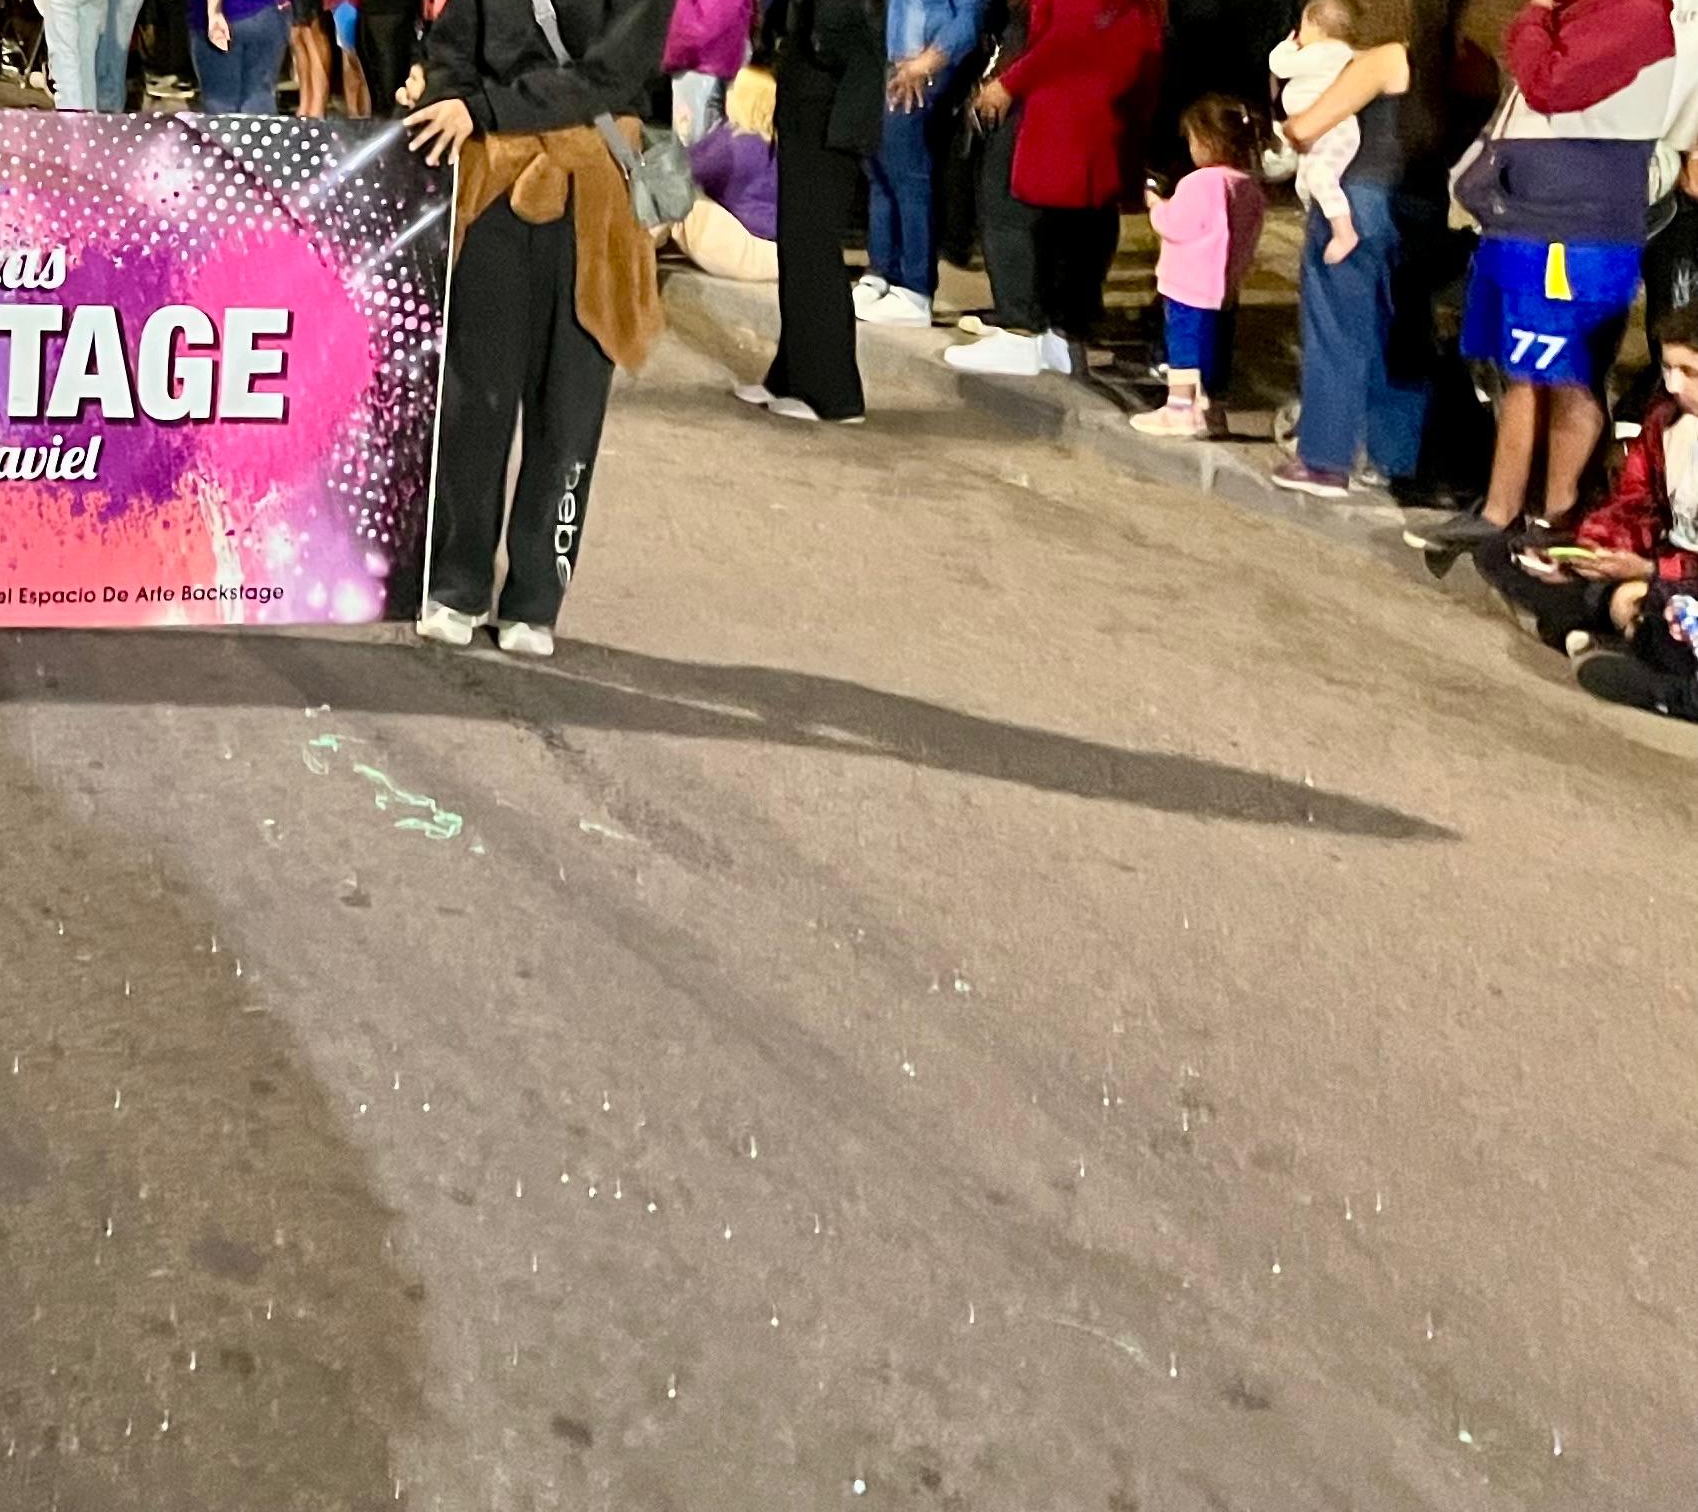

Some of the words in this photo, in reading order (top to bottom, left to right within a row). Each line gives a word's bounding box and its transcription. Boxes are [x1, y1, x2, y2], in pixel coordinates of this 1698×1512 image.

[1509, 328, 1568, 370] 77
[18, 586, 97, 608] Espacio
[102, 585, 130, 604] De
[134, 585, 176, 604] Arte
[181, 584, 285, 605] Backstage
